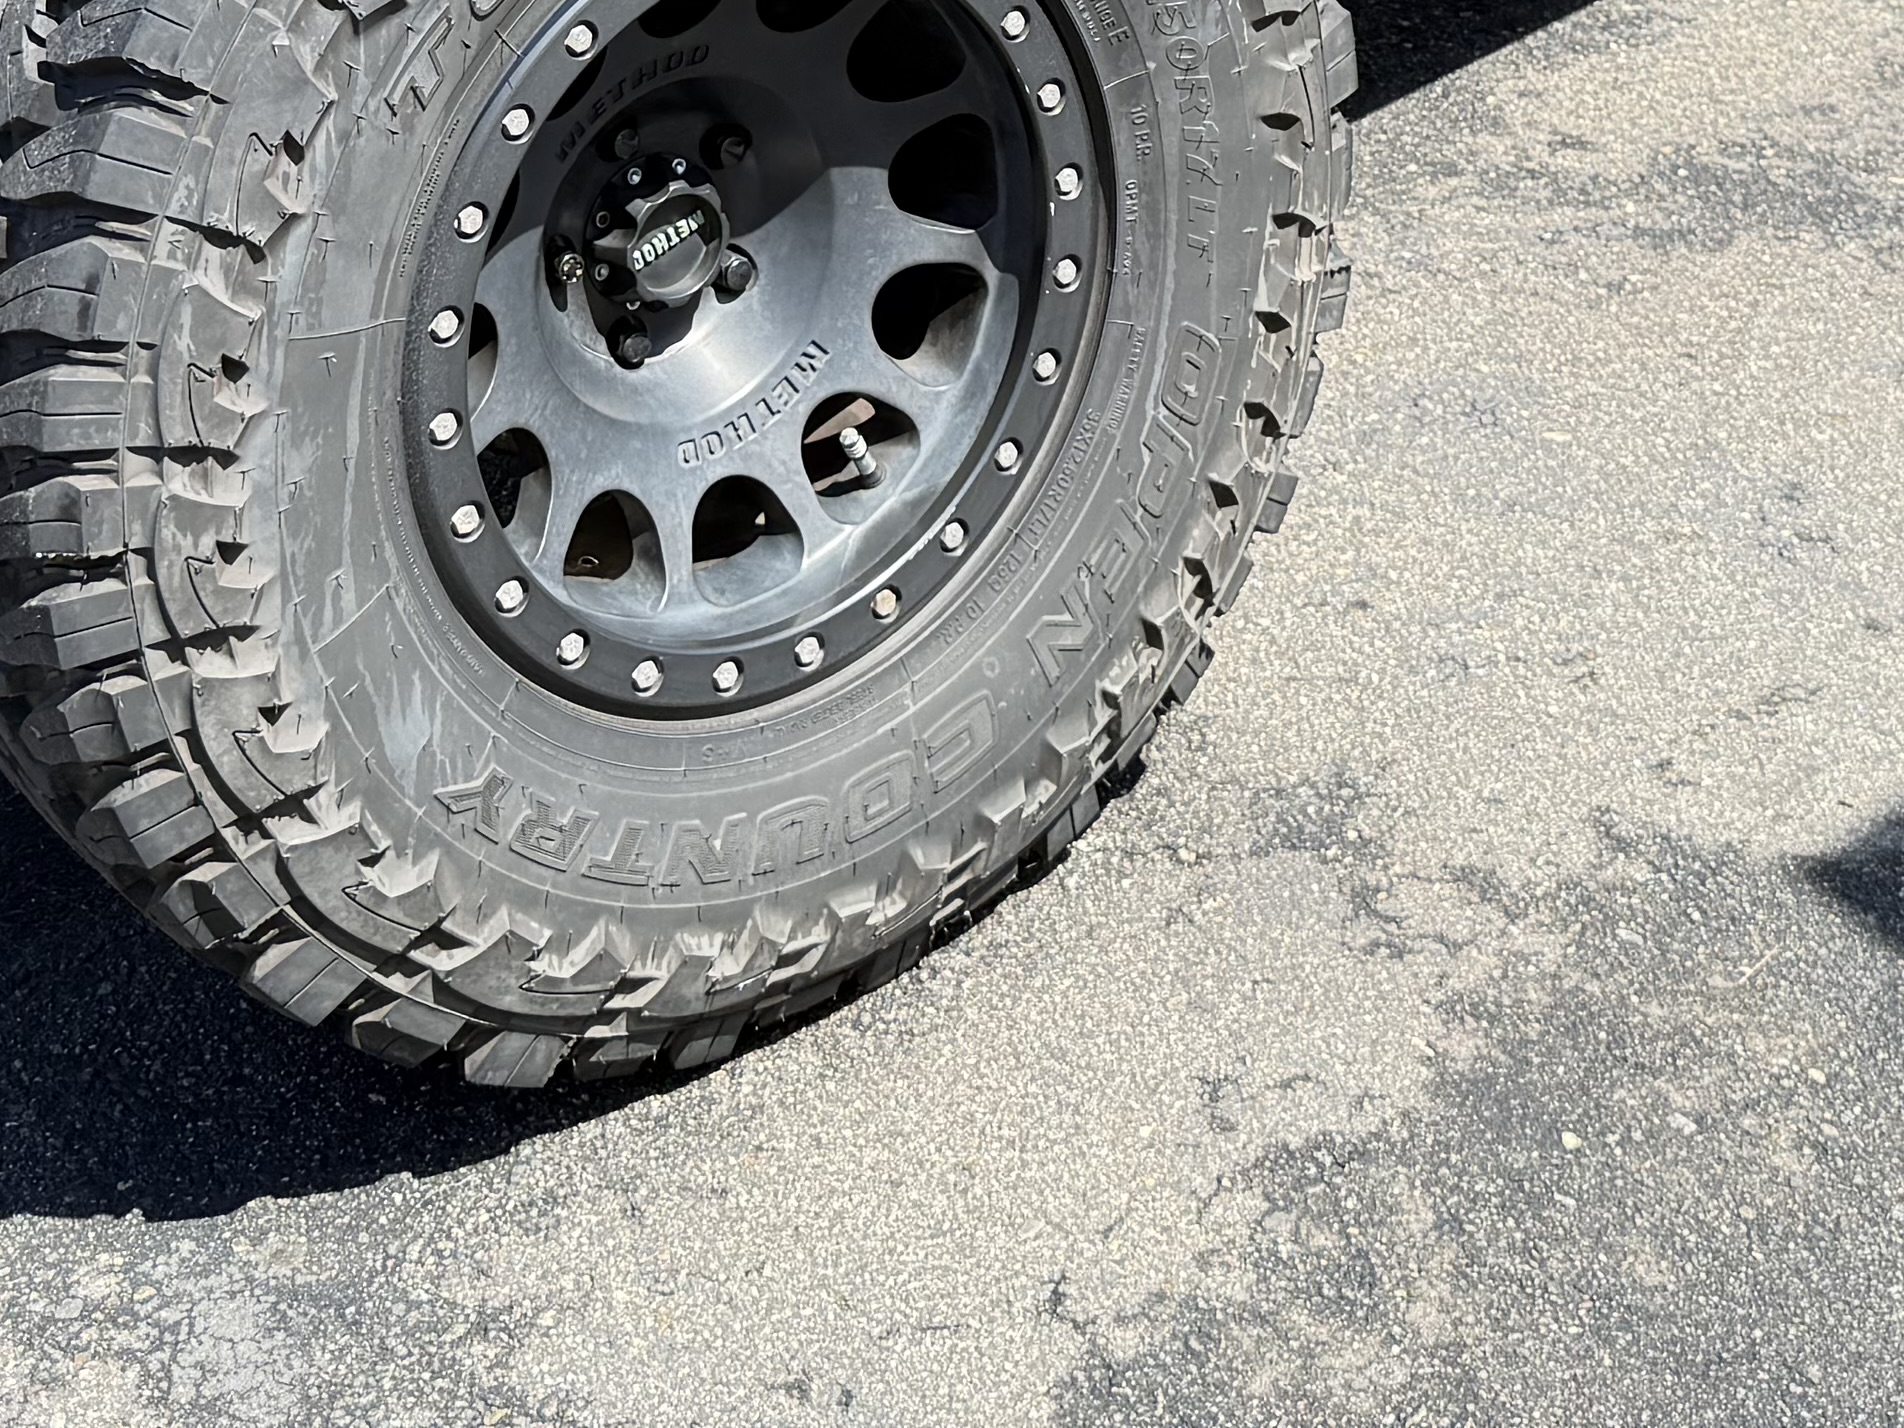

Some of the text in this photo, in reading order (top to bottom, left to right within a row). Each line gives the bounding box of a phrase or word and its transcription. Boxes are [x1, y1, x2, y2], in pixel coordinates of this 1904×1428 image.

[1106, 23, 1131, 47] E
[552, 42, 710, 164] METHOD
[1129, 103, 1148, 127] 10
[631, 209, 707, 272] METHOD
[678, 338, 832, 468] METHOD
[430, 317, 1222, 888] OPEN COUNTRY
